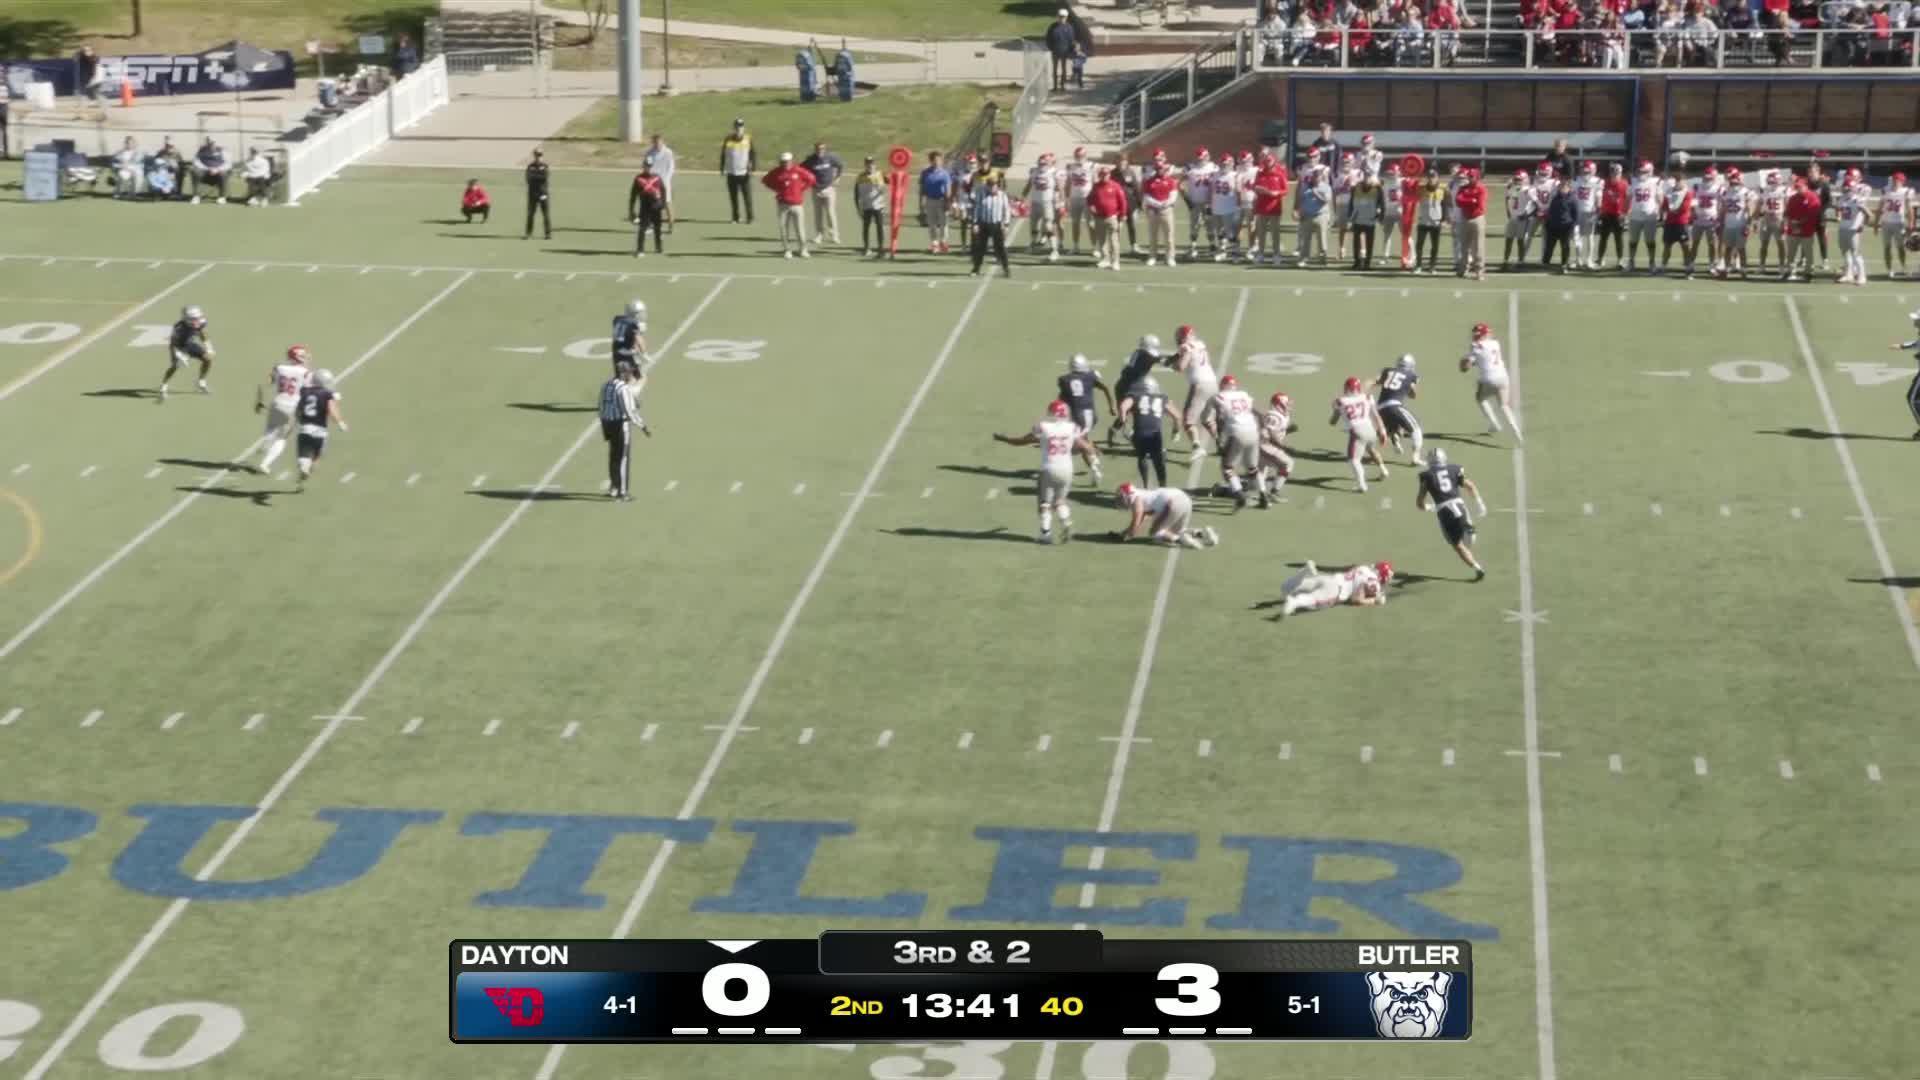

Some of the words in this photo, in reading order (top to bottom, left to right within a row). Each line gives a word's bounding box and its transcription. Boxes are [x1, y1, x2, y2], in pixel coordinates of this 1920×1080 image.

[1383, 370, 1406, 390] 15
[303, 394, 319, 417] 2
[1437, 470, 1452, 493] 5
